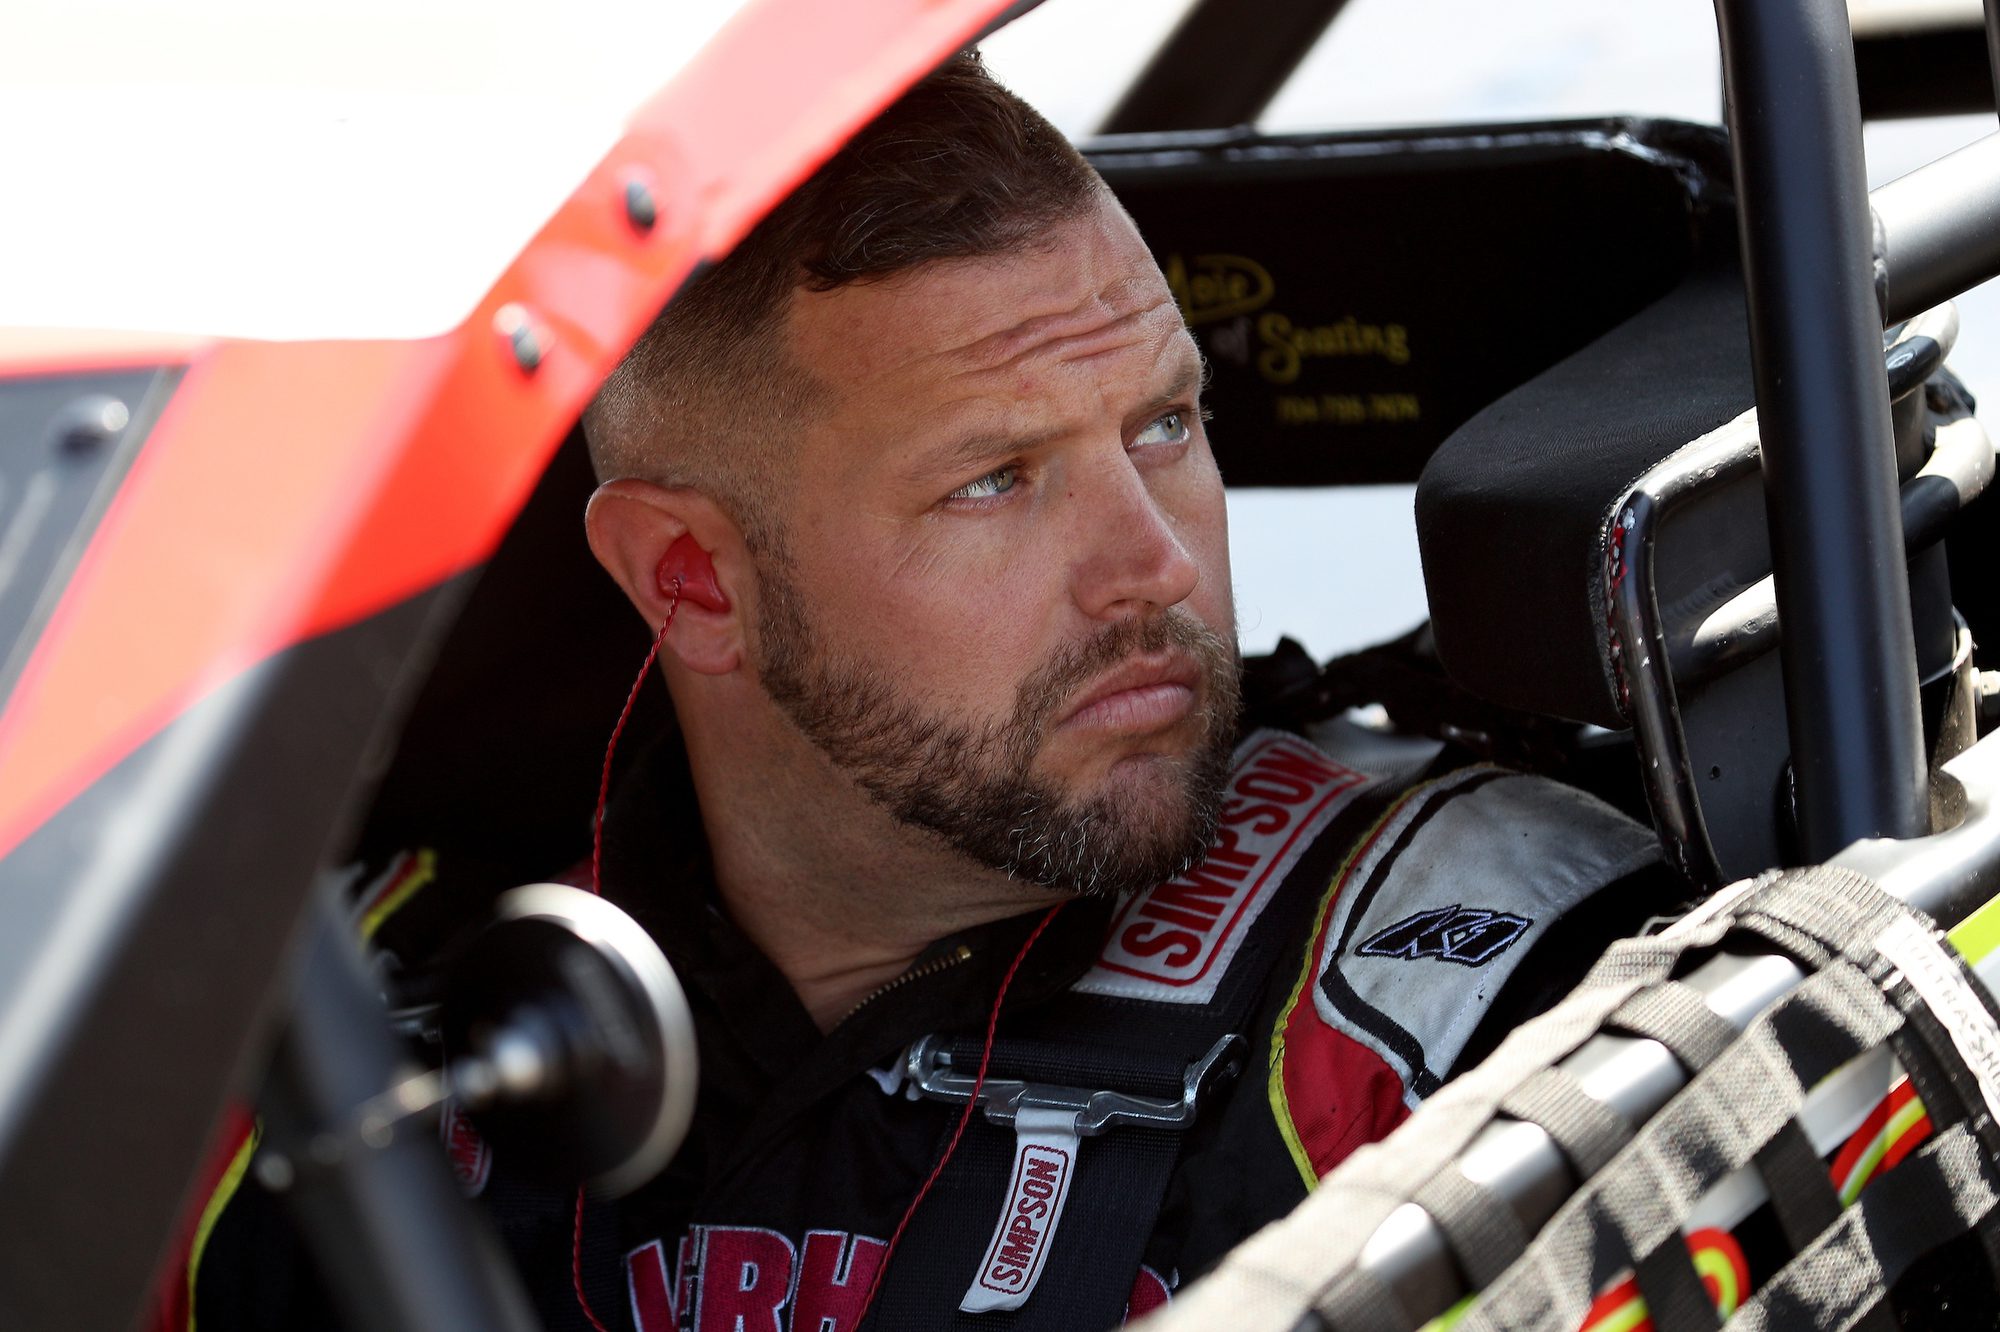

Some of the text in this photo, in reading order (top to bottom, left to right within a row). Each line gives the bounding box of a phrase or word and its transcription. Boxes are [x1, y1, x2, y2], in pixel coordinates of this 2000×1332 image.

[1257, 311, 1411, 384] Seating
[1120, 746, 1340, 969] SIMPSON
[991, 1157, 1060, 1286] SIMPSON
